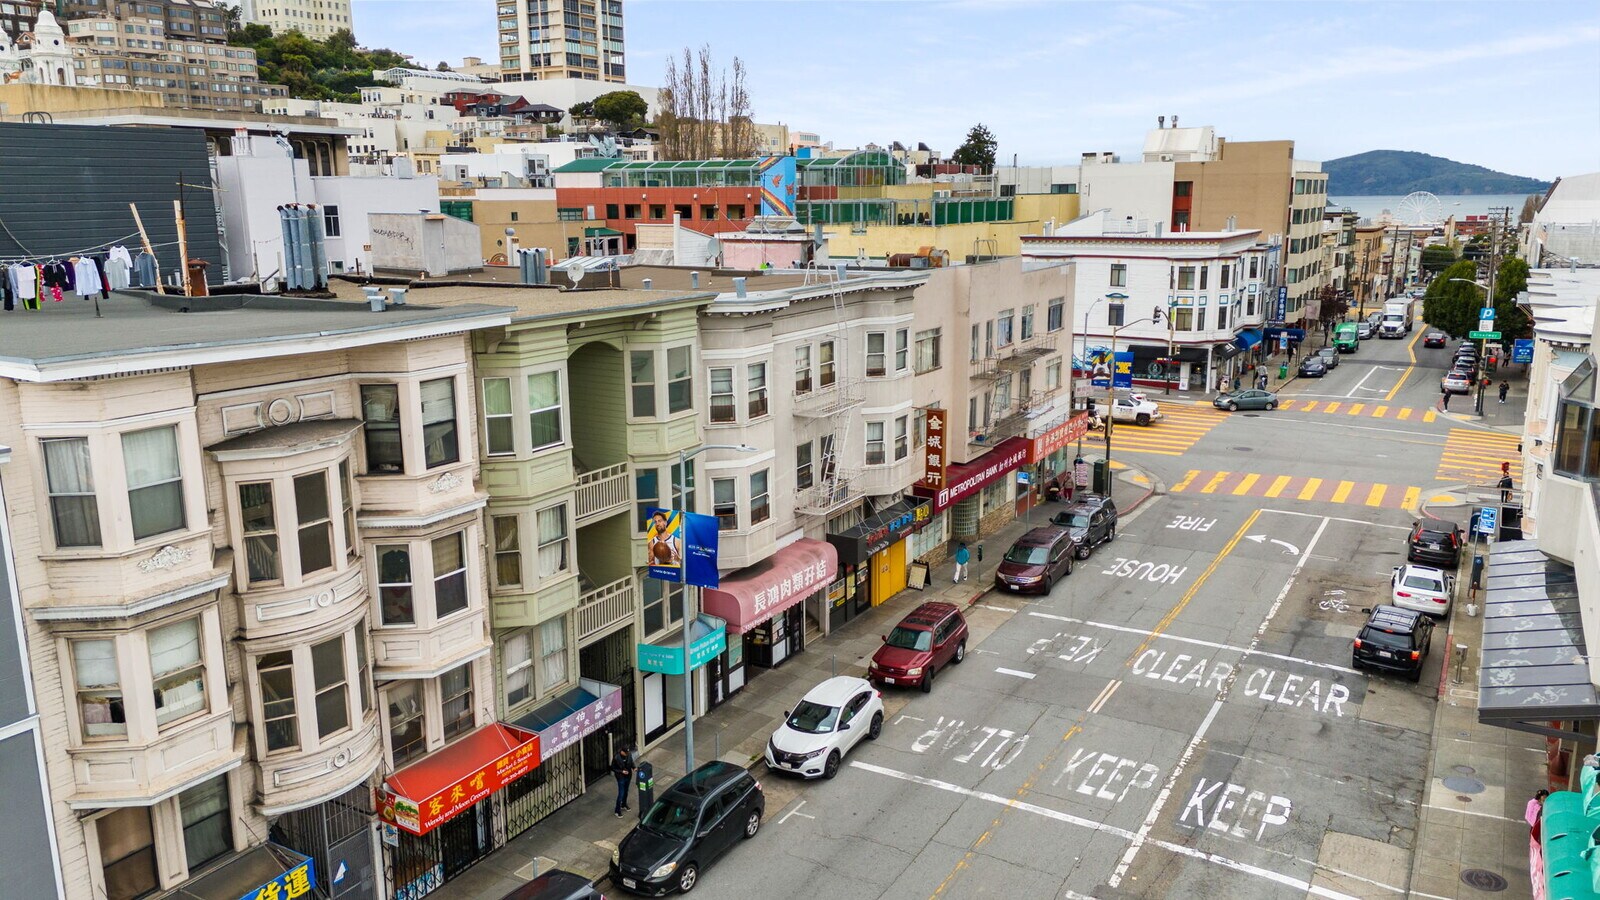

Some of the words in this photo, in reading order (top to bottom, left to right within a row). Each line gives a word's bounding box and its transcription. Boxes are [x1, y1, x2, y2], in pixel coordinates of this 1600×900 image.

[1483, 309, 1492, 318] P
[927, 415, 943, 485] 金城銀行
[950, 471, 985, 498] METROPOLITAN
[985, 464, 998, 479] BANK
[1166, 515, 1218, 532] FIRE
[1101, 557, 1188, 585] HOUSE
[1132, 650, 1235, 692] CLEAR
[1244, 668, 1350, 717] CLEAR
[496, 763, 513, 776] Market
[1052, 748, 1160, 802] KEEP
[424, 814, 445, 828] Wendy
[445, 806, 455, 817] and
[455, 799, 470, 811] Moon
[470, 788, 490, 802] Grocery
[1179, 778, 1292, 842] KEEP
